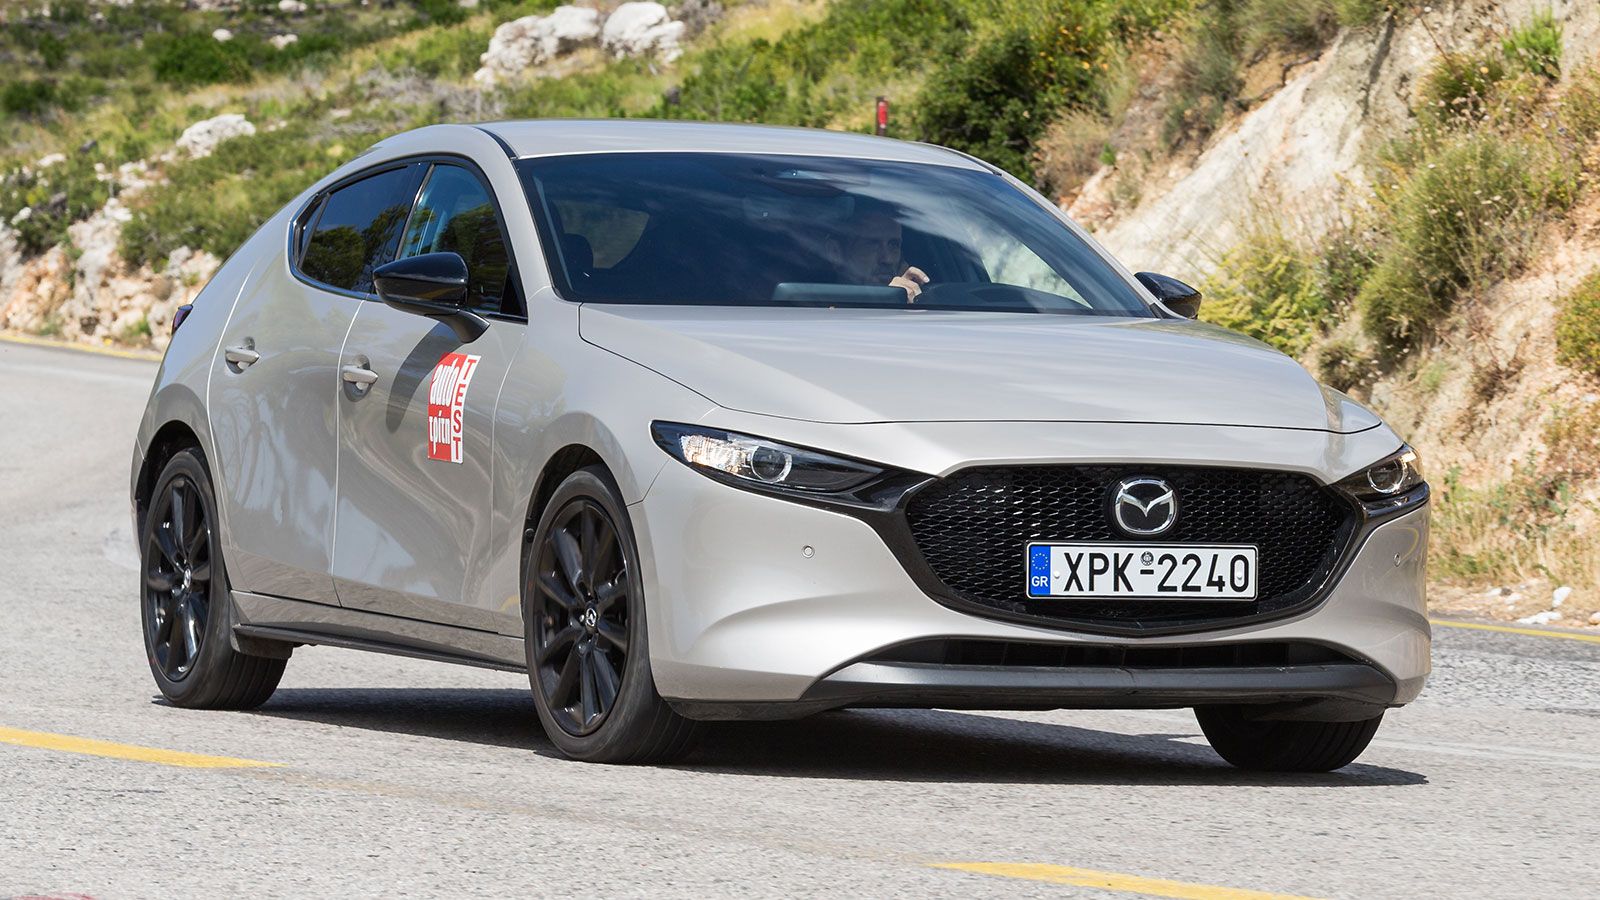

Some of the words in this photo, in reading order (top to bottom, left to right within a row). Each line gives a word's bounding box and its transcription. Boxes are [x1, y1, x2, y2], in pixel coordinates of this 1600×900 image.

[430, 357, 460, 407] auto
[453, 359, 477, 460] TEST
[1031, 576, 1049, 587] GR
